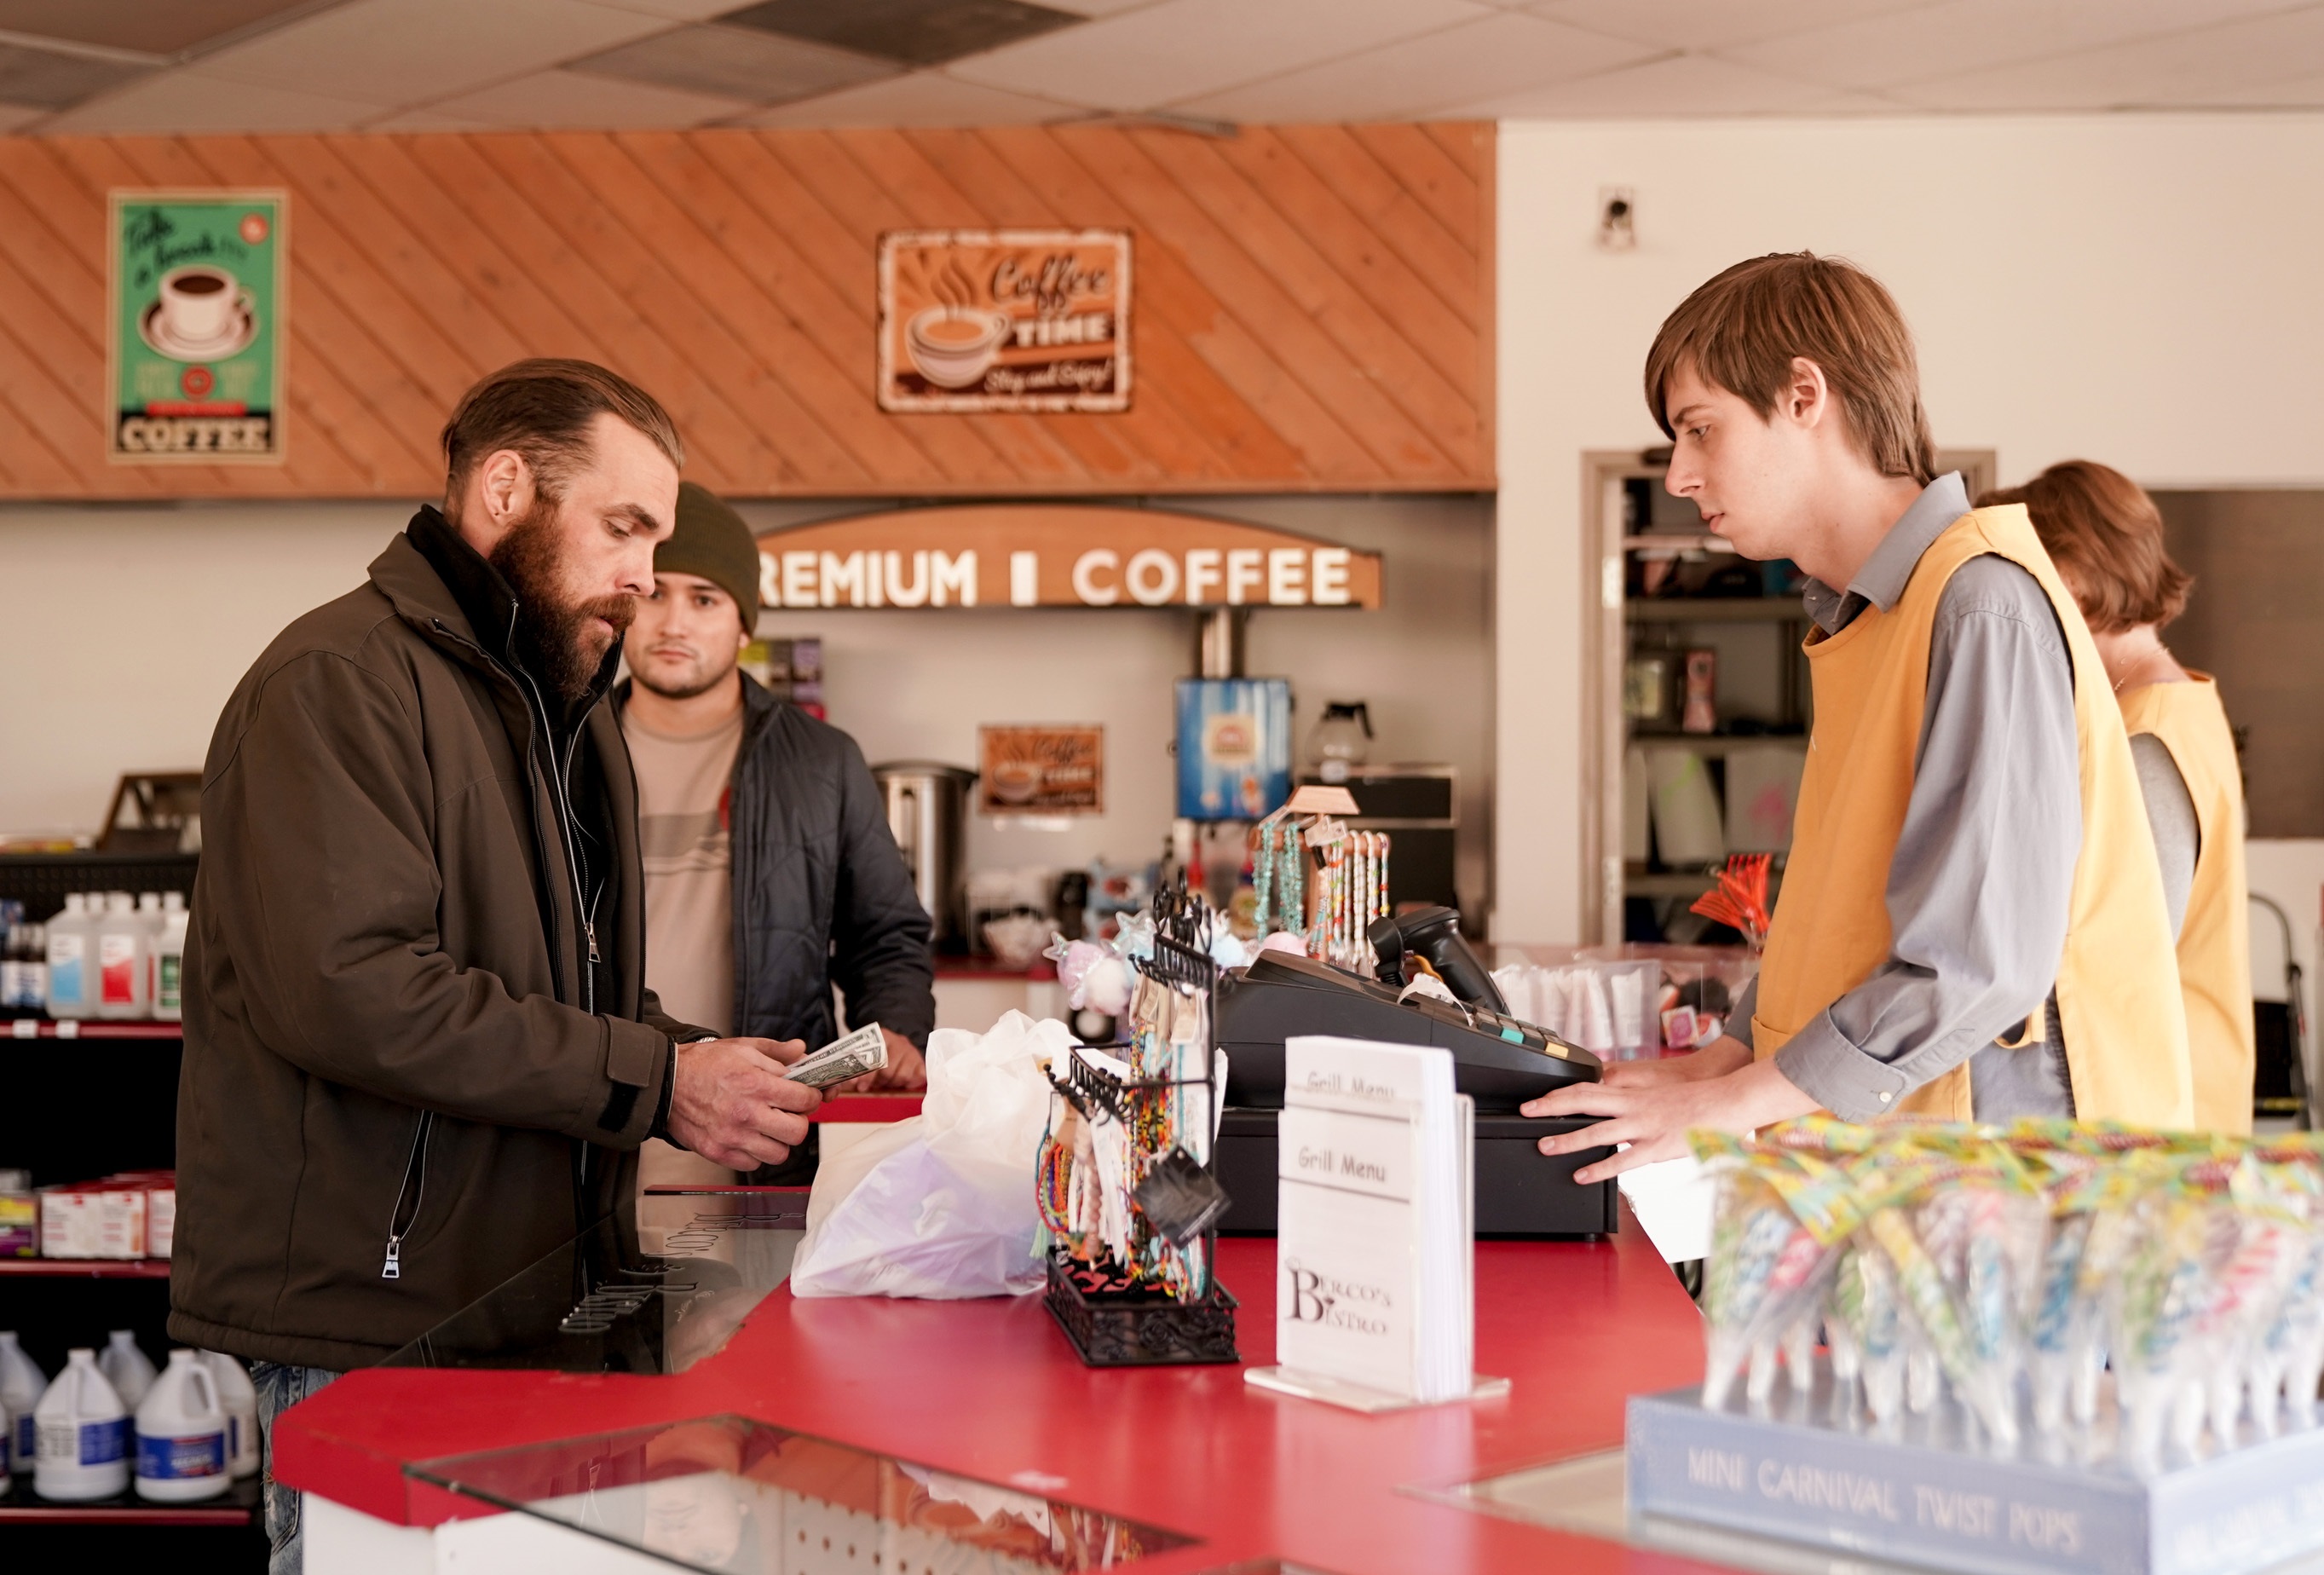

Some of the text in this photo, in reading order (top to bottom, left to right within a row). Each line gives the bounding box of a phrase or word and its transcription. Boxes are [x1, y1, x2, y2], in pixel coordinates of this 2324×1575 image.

[990, 255, 1107, 314] Coffee
[1012, 314, 1106, 346] TIME
[122, 416, 268, 452] COFFEE
[758, 548, 1352, 608] REMIUM COFFEE
[1306, 1070, 1341, 1092] Grill
[1298, 1145, 1386, 1182] Grill Menu
[1688, 1447, 2082, 1556] MINI CARNIVAL TWIST POPS
